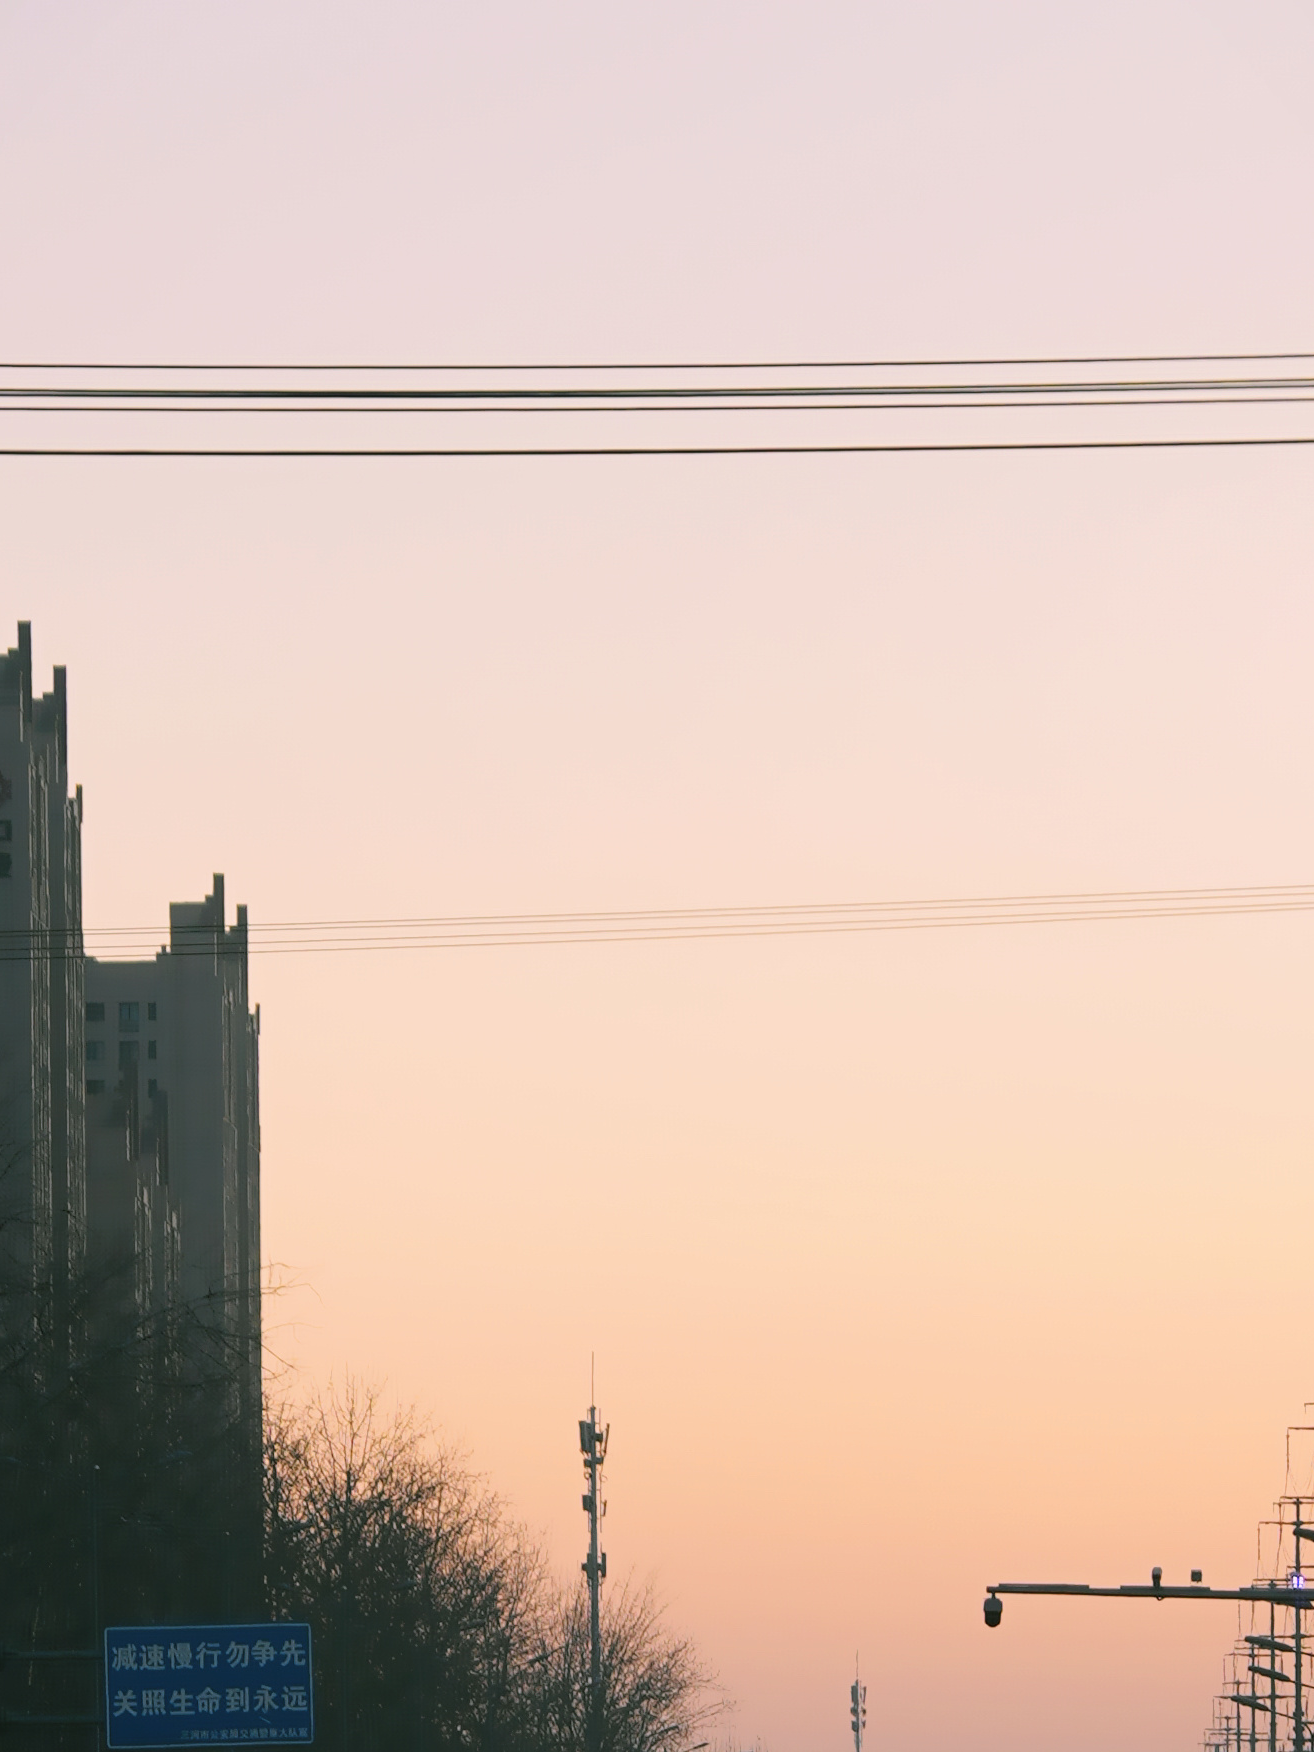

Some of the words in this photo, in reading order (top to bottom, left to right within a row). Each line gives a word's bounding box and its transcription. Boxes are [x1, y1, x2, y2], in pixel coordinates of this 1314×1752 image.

[111, 1639, 306, 1671] 减速慢行勿争先
[113, 1684, 308, 1718] 关照生命到永远
